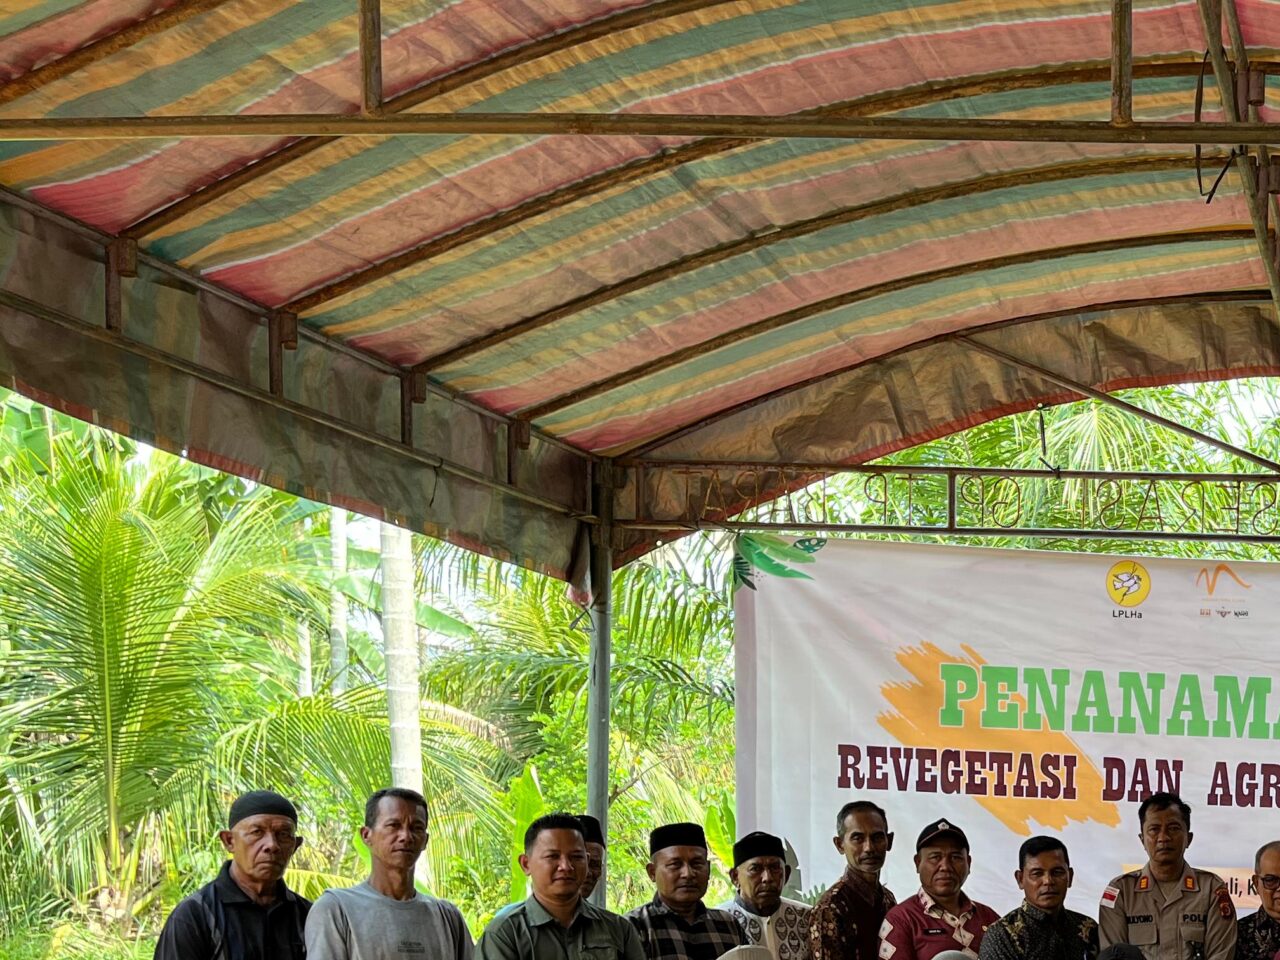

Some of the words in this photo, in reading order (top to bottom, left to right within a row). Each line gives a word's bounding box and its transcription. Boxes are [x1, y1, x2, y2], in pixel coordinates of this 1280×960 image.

[1112, 609, 1143, 619] LPLHa
[837, 744, 1077, 800] REVEGETASI
[1102, 757, 1184, 803] DAN
